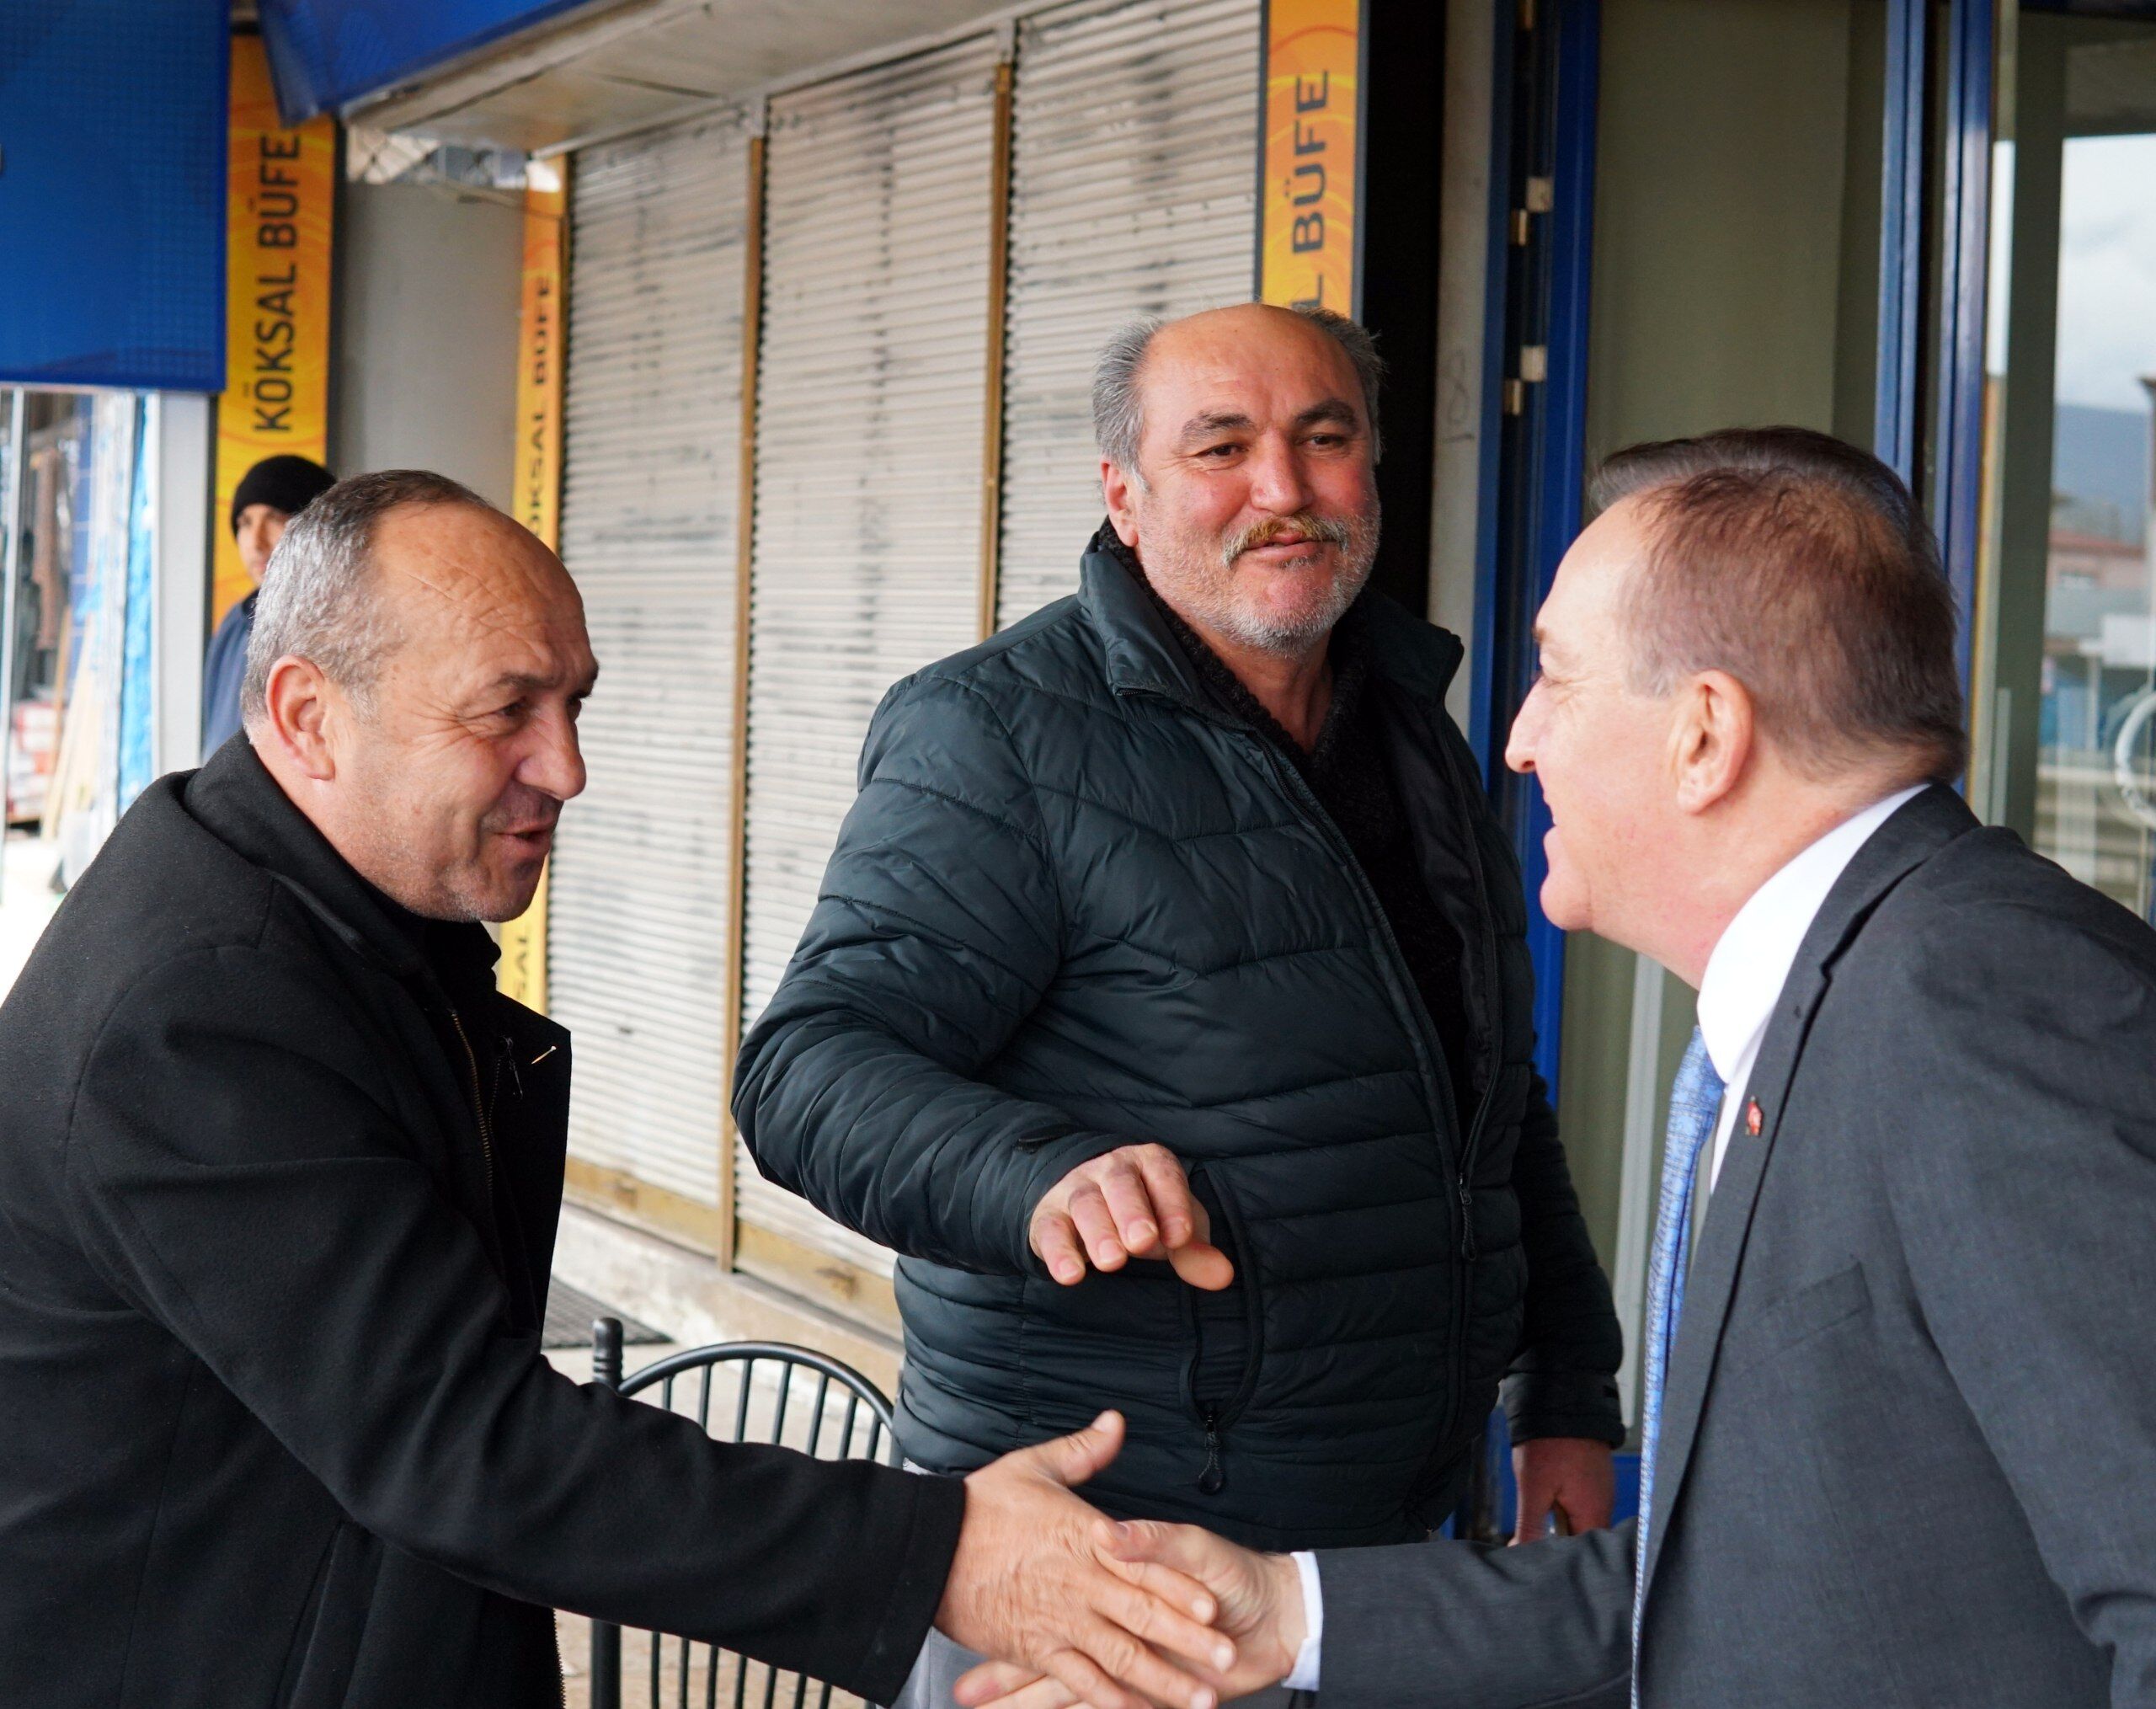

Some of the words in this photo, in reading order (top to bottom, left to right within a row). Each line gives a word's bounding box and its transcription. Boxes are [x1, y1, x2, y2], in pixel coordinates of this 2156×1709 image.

[248, 135, 299, 248] BÜFE
[1283, 70, 1329, 254] BÜFE
[243, 263, 296, 432] KÖKSAL
